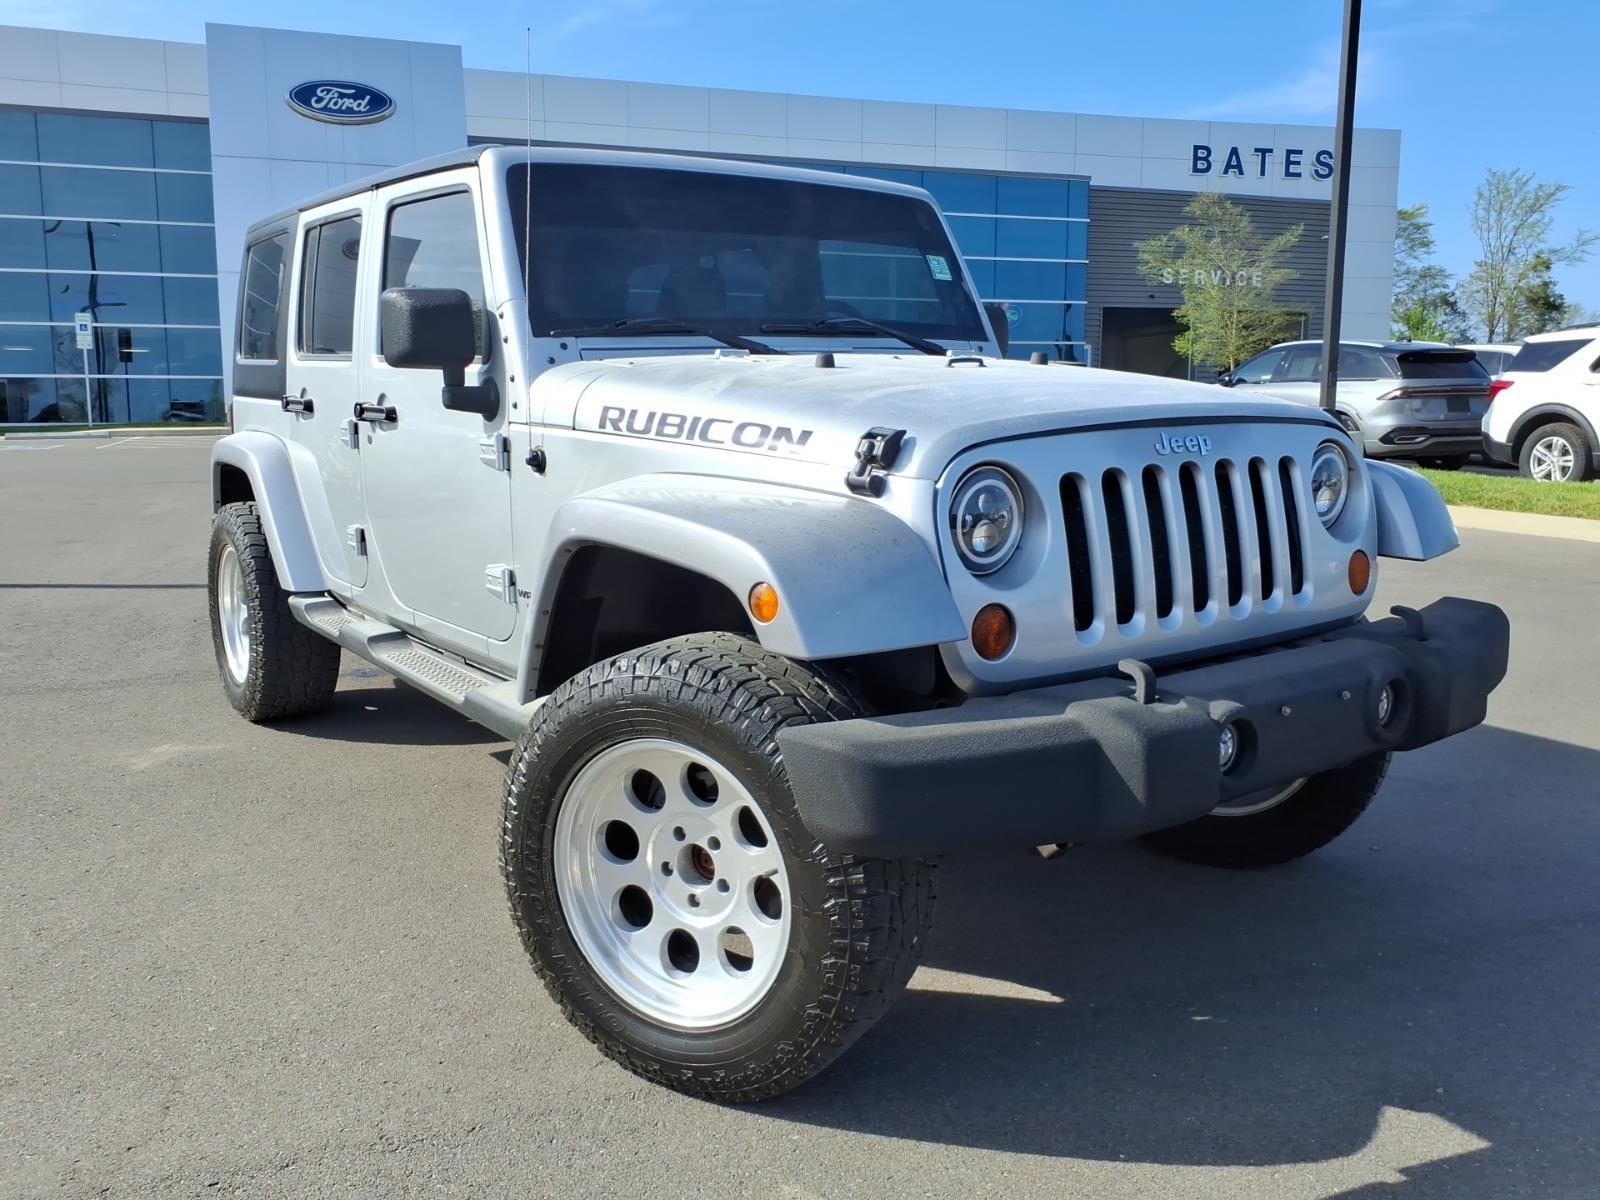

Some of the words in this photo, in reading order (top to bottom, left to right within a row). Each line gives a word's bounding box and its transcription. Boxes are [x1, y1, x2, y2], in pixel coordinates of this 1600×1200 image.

[311, 86, 370, 112] Ford
[1191, 144, 1334, 180] BATES
[1161, 267, 1262, 287] SERVICE
[598, 405, 814, 452] RUBICON
[1154, 431, 1212, 456] Jeep
